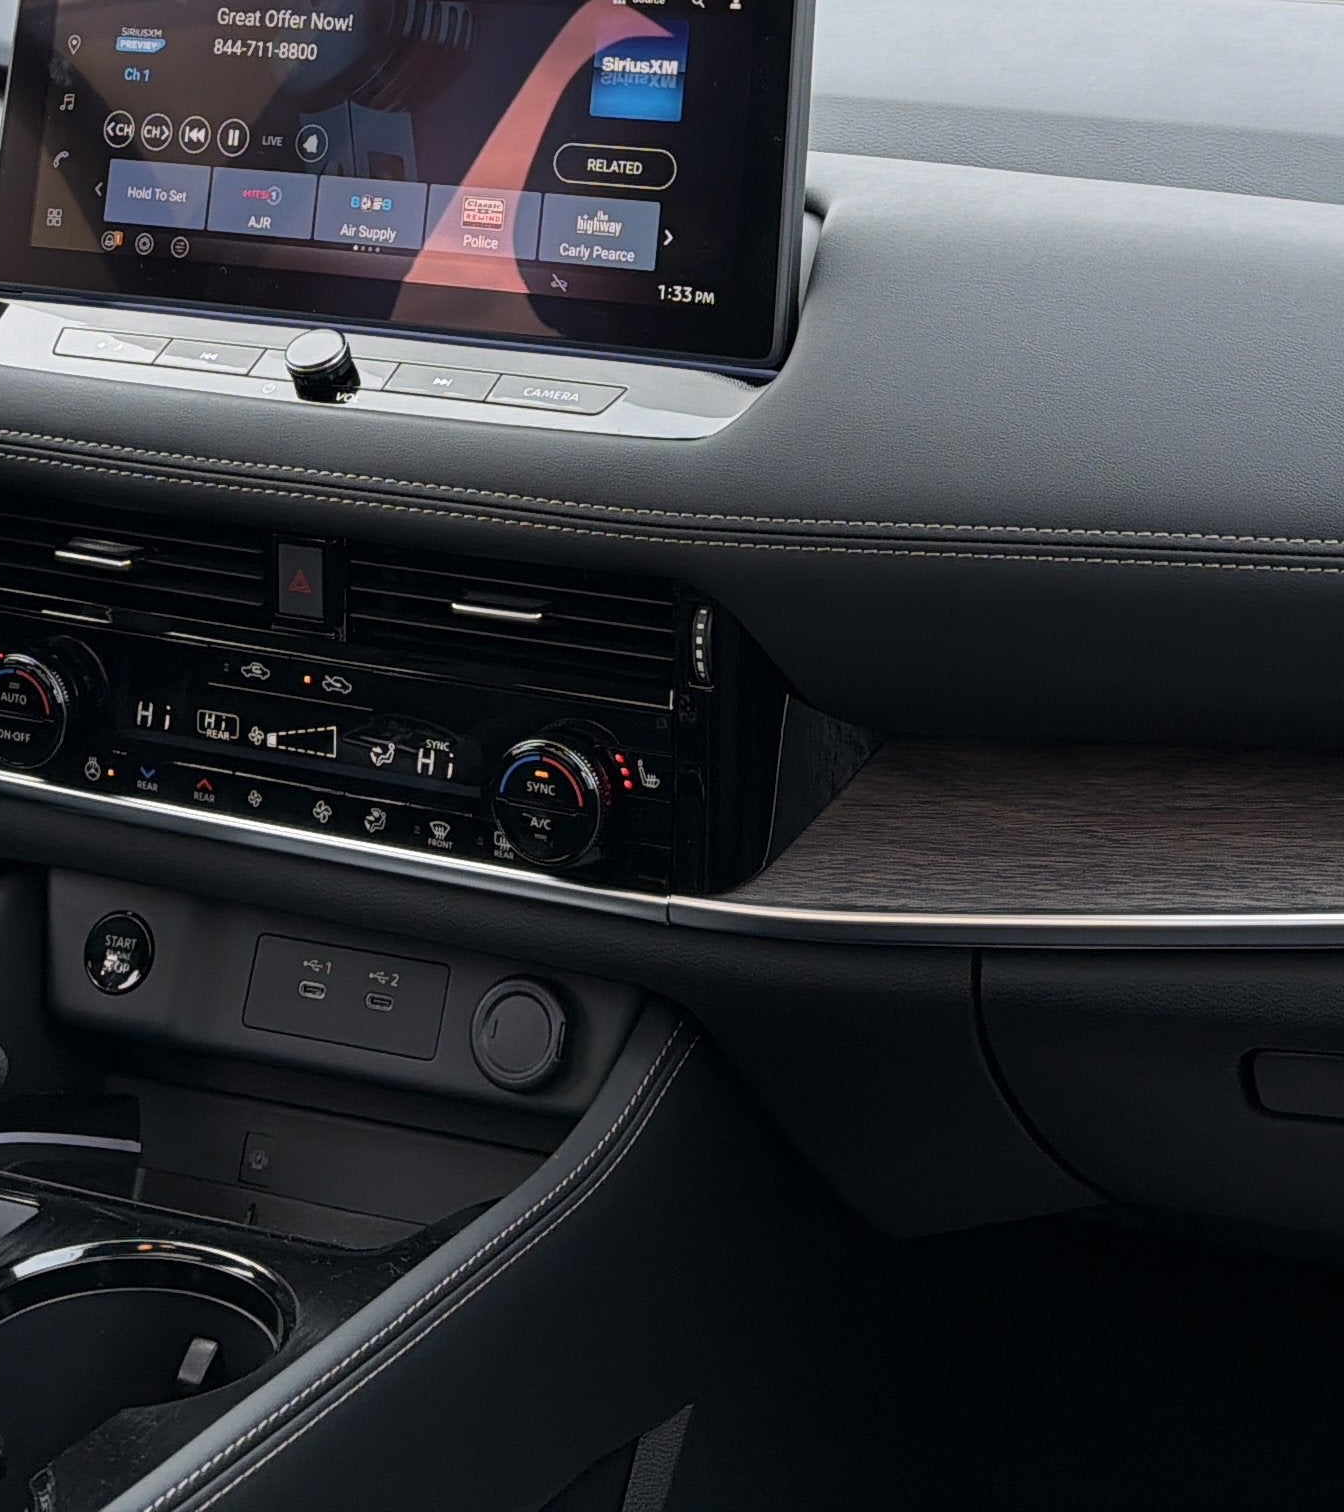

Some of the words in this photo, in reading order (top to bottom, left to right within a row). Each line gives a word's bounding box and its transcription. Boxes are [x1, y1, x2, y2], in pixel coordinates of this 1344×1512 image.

[217, 7, 261, 27] Great
[265, 9, 307, 30] Offer
[310, 11, 354, 32] Now!
[213, 39, 318, 61] 844-711-8800
[601, 56, 678, 75] SiriusXM
[124, 67, 141, 82] Ch
[143, 68, 151, 82] 1
[262, 135, 284, 148] LIVE
[587, 157, 643, 175] RELATED
[127, 187, 153, 200] Hold
[154, 188, 168, 202] To
[168, 189, 188, 203] Set
[466, 199, 503, 210] Classic
[247, 215, 272, 229] AJR
[465, 212, 502, 223] REWIND
[596, 209, 609, 221] the
[339, 223, 358, 237] Air
[358, 224, 397, 242] Supply
[576, 215, 623, 237] highway
[462, 233, 499, 250] Police
[559, 242, 591, 262] Carly
[593, 245, 636, 263] Pearce
[657, 284, 693, 303] 1:33
[694, 290, 715, 305] PM
[522, 386, 580, 403] CAMERA
[0, 691, 28, 705] AUTO
[206, 729, 230, 741] REAR
[425, 738, 450, 752] SYNC
[136, 780, 159, 792] REAR
[526, 780, 556, 796] SYNC
[193, 791, 215, 803] REAR
[529, 816, 552, 831] A/C
[427, 837, 453, 850] FRONT
[493, 849, 514, 860] REAR
[104, 934, 137, 949] START
[324, 960, 332, 975] 1
[390, 972, 400, 987] 2
